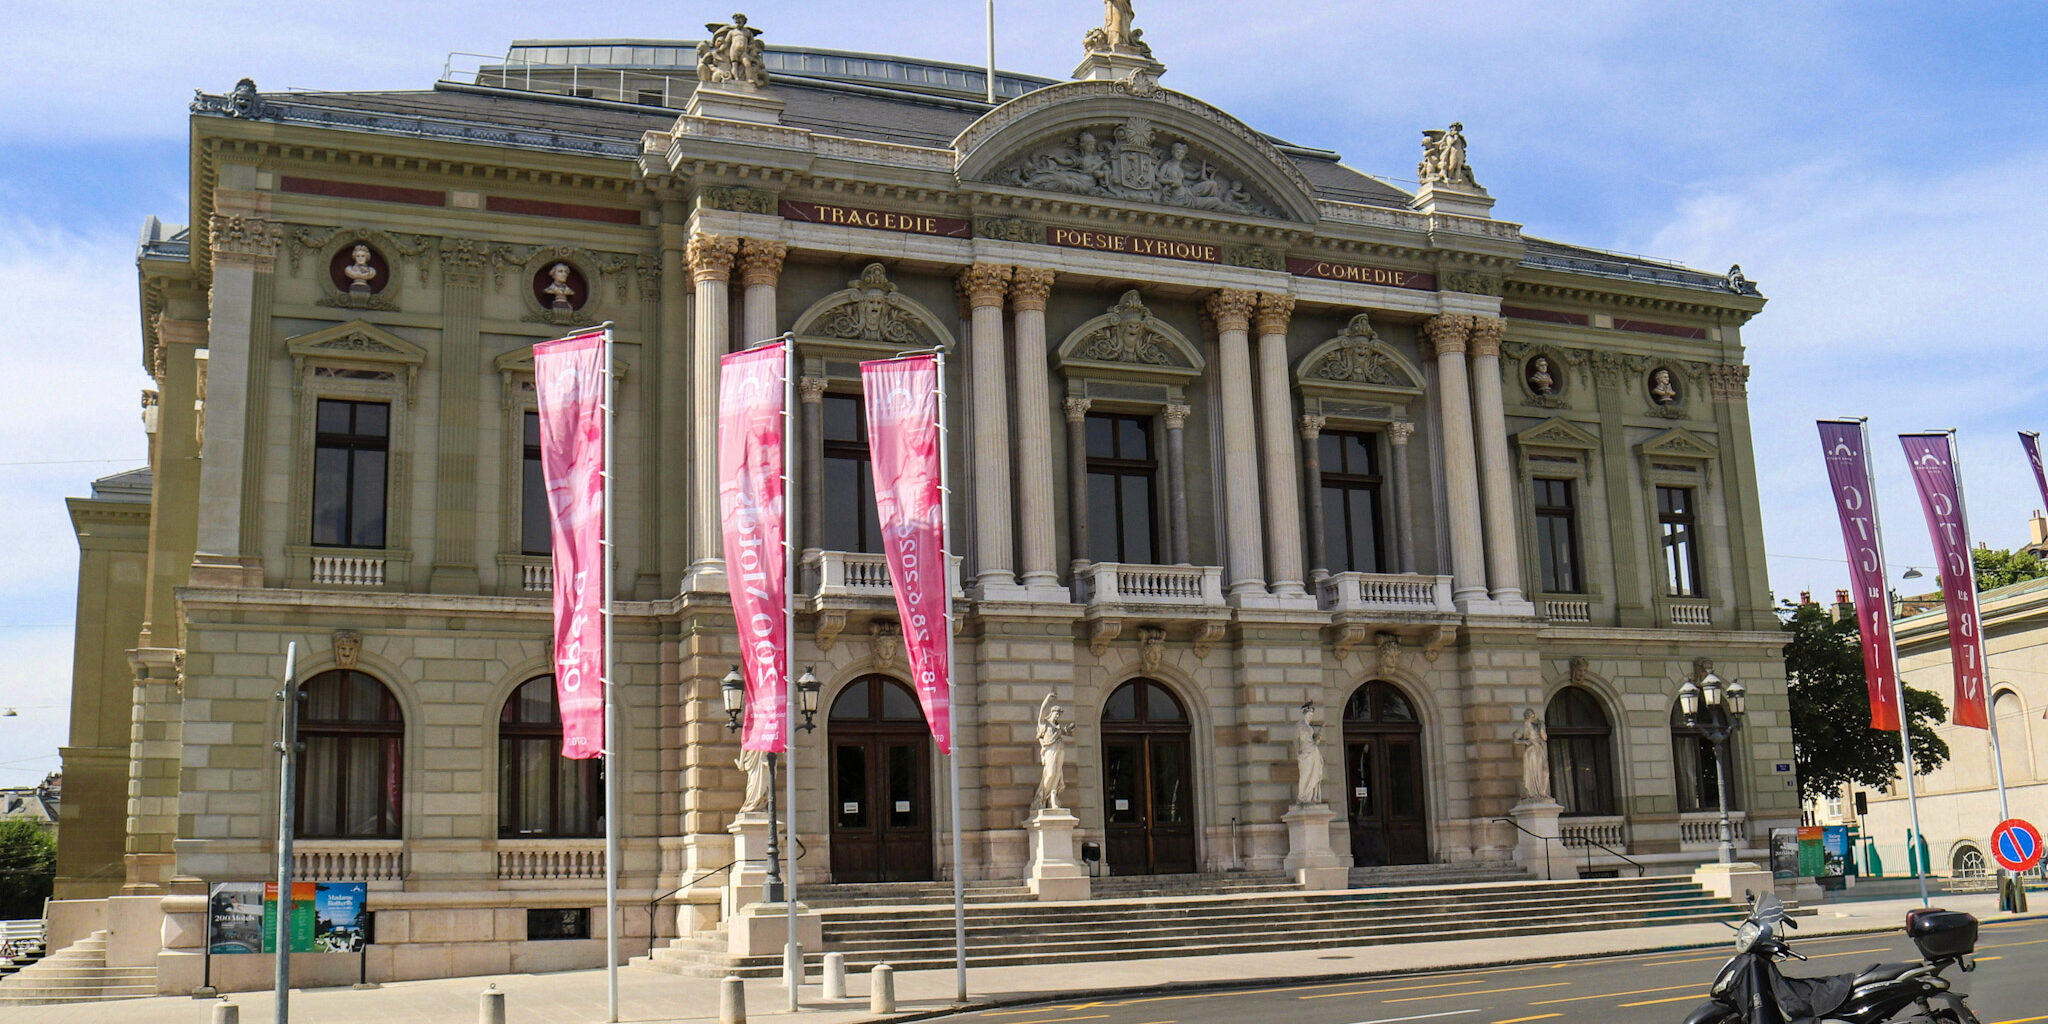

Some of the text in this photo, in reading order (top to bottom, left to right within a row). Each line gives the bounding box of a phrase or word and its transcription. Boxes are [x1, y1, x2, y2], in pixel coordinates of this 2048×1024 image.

[814, 204, 938, 234] TRAGEDIE
[1055, 228, 1217, 262] POESIE LYRIQUE
[1316, 262, 1405, 287] COMEDIE
[214, 914, 231, 922] 200
